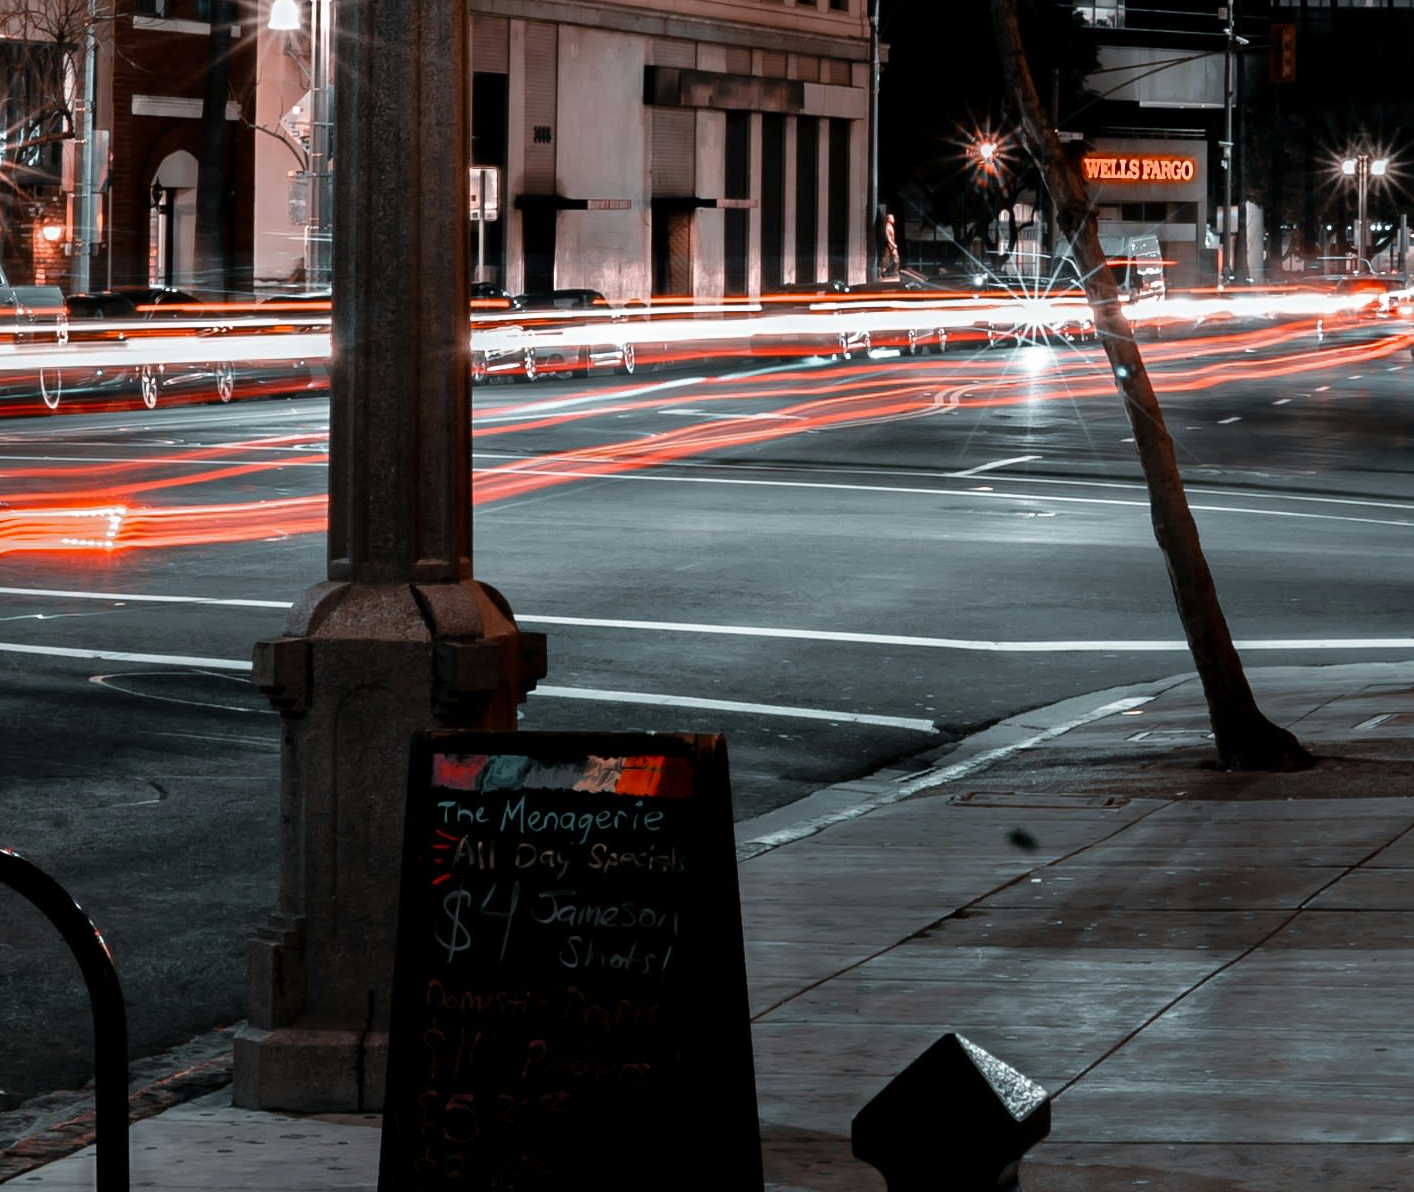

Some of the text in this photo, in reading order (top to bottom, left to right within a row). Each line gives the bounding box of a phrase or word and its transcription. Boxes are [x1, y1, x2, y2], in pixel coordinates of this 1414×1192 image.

[1084, 158, 1194, 180] WELLS FARGO
[437, 796, 665, 845] The Menagerie
[452, 833, 496, 870] All
[514, 842, 572, 880] Day
[434, 880, 679, 965] $4 Jameson
[559, 935, 673, 975] Shots!
